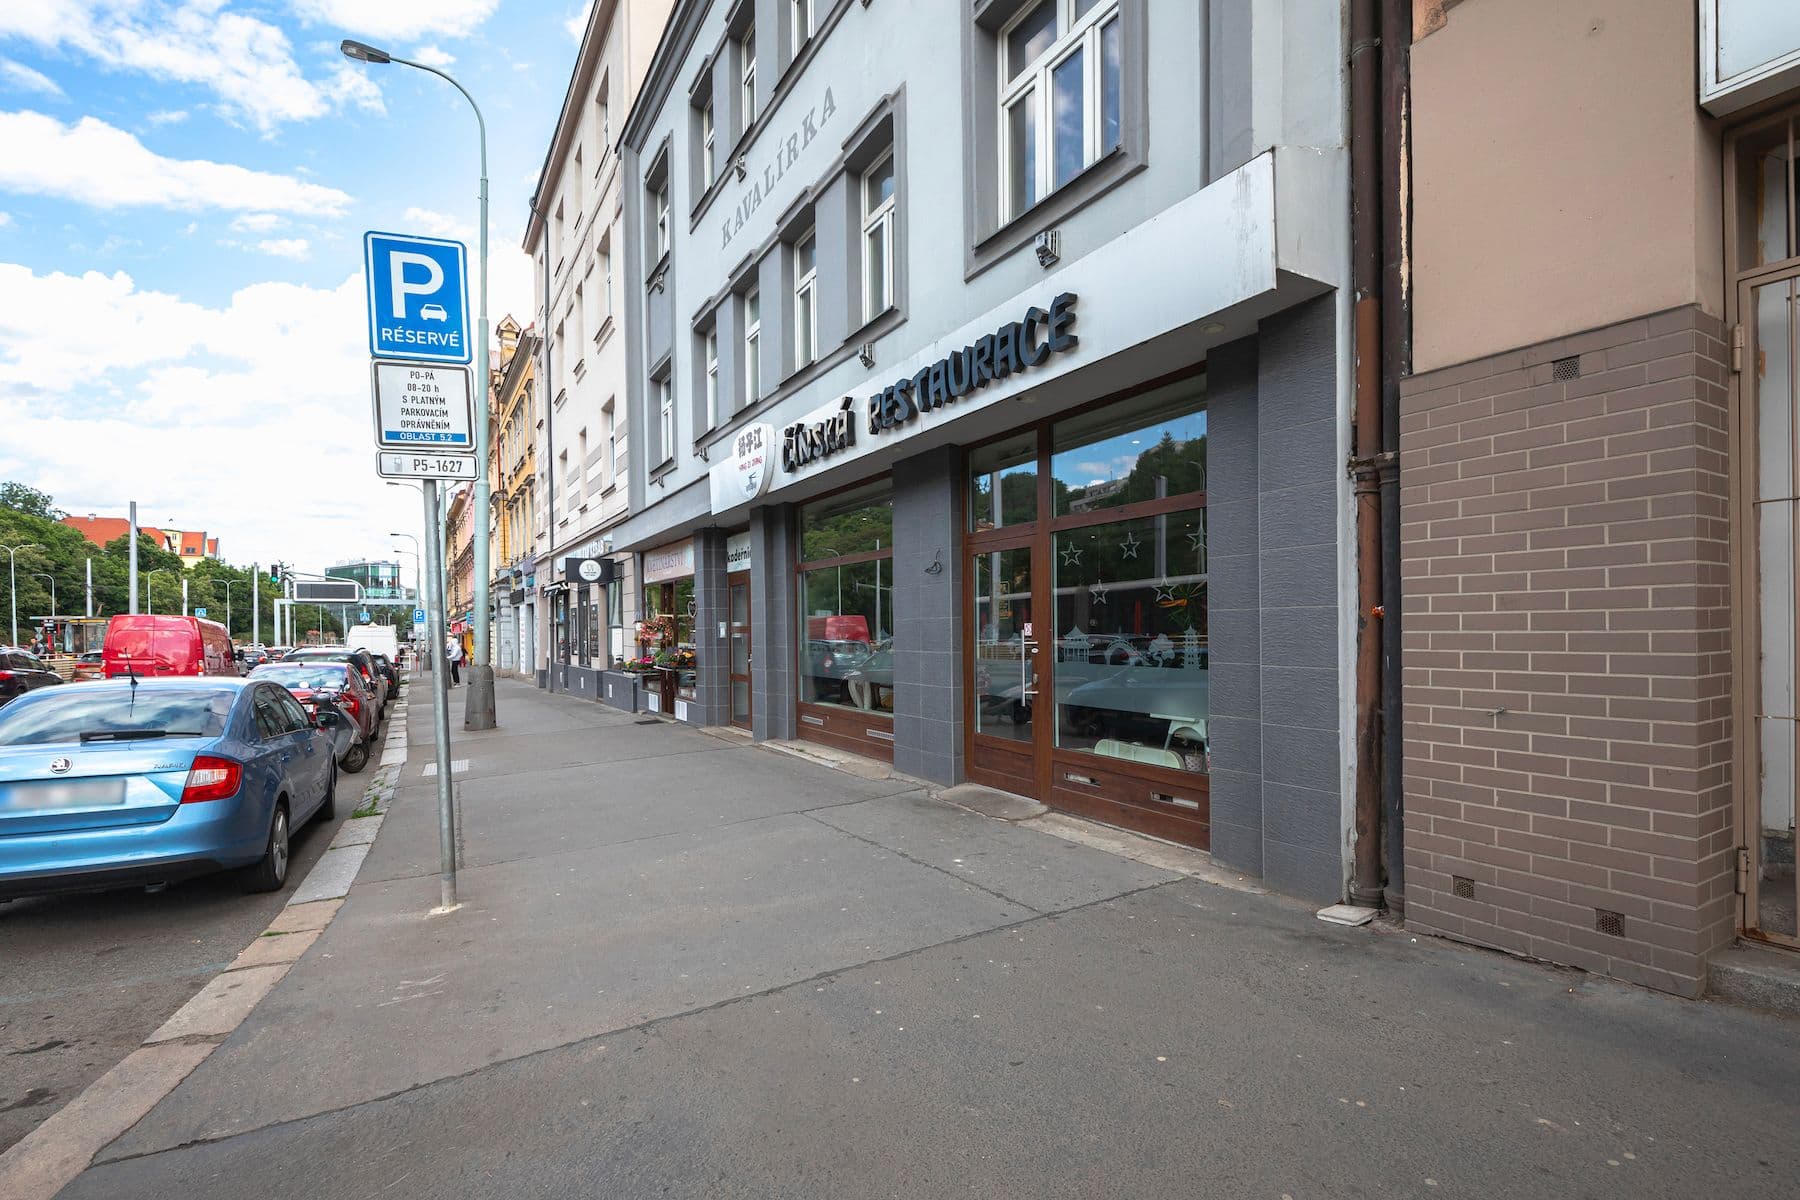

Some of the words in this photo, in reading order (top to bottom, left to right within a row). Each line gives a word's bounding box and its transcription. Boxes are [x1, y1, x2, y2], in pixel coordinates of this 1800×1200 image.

[721, 86, 837, 250] KAVALÍRKA
[390, 250, 444, 319] P
[381, 326, 460, 347] RÉSERVÉ
[867, 291, 1080, 435] RESTAURACE
[410, 370, 435, 381] PO-PÁ
[407, 383, 431, 392] 08-20
[434, 384, 440, 393] h
[402, 395, 408, 404] S
[411, 395, 446, 405] PLATNÝM
[400, 407, 449, 418] PARKOVACÍM
[400, 419, 451, 430] OPRÁVNĚNÍM
[400, 432, 435, 441] OBLAST
[440, 433, 453, 442] 5.2
[413, 459, 462, 473] P5-1627
